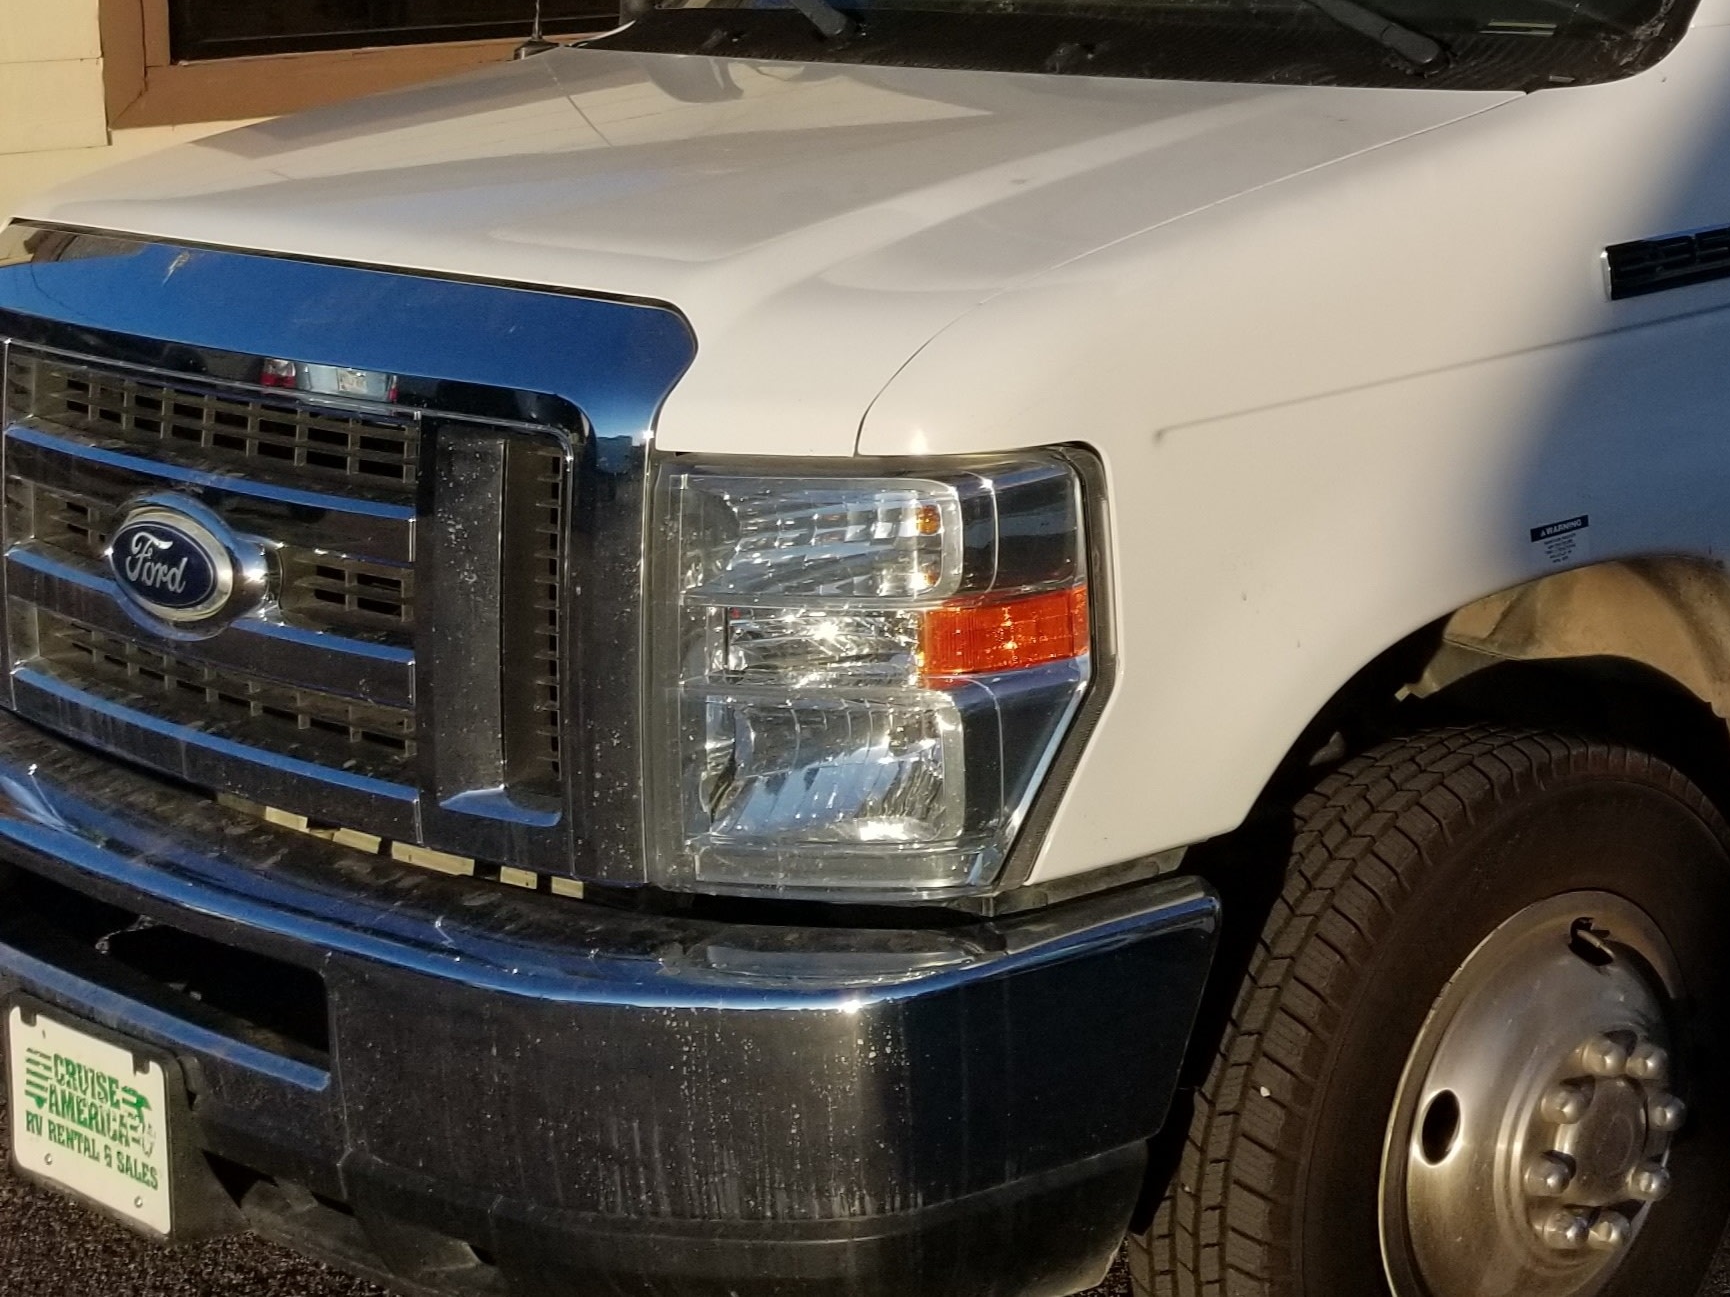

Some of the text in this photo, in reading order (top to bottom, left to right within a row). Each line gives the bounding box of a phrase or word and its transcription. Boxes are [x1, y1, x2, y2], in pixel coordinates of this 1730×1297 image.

[125, 531, 189, 594] Ford
[53, 1053, 121, 1110] CRUISE
[48, 1085, 131, 1148] AMERICA
[26, 1110, 43, 1137] RV
[48, 1119, 100, 1162] RENTAL
[117, 1151, 159, 1191] SALES
